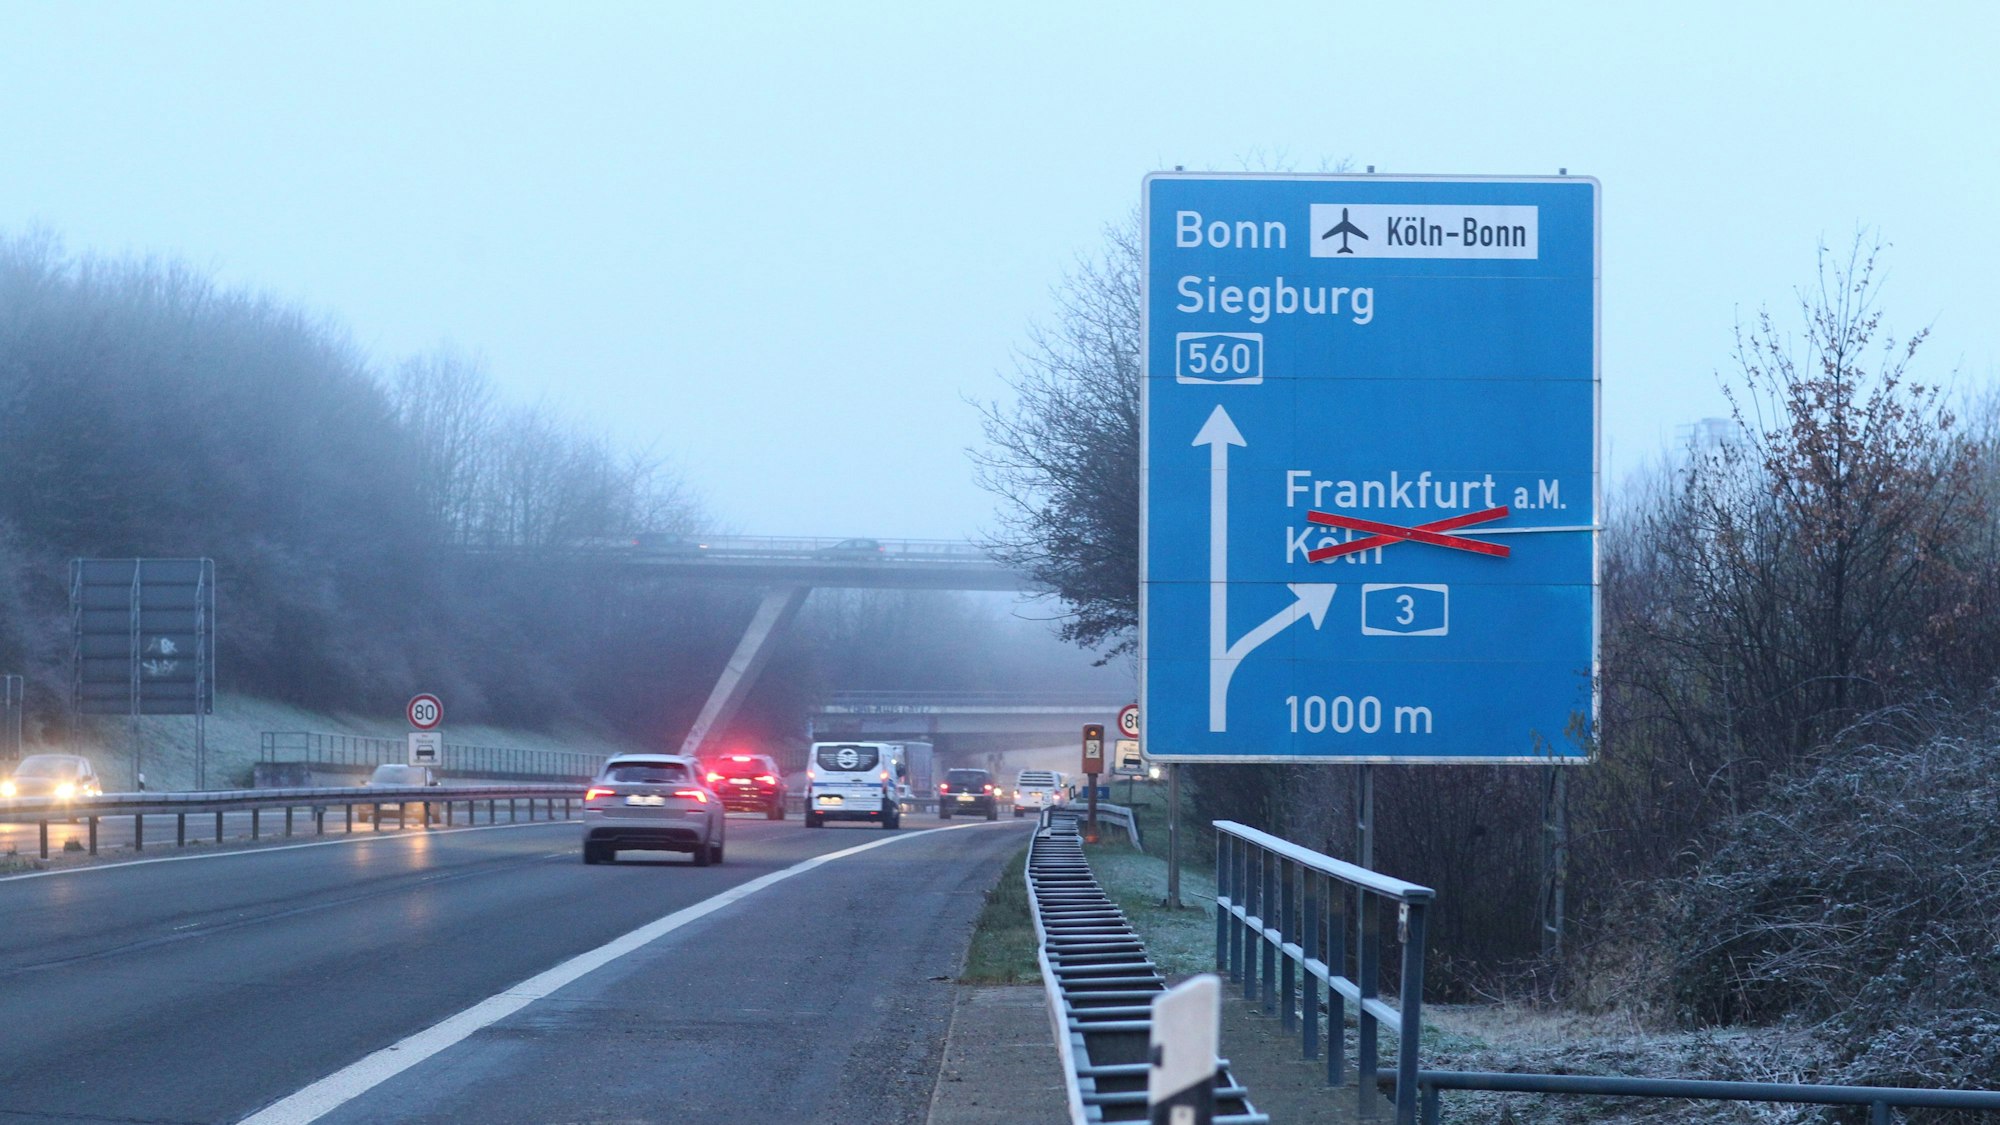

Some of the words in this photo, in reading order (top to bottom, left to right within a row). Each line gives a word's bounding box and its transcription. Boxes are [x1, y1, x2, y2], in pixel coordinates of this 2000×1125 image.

[1176, 210, 1287, 249] Bonn
[1387, 216, 1526, 247] Köln-Bonn
[1176, 275, 1375, 325] Siegburg
[1189, 342, 1250, 374] 560
[1286, 469, 1496, 509] Frankfurt
[1514, 479, 1568, 510] a.M.
[1395, 594, 1415, 625] 3
[414, 704, 435, 721] 80
[1285, 695, 1382, 734] 1000
[1394, 706, 1433, 734] m
